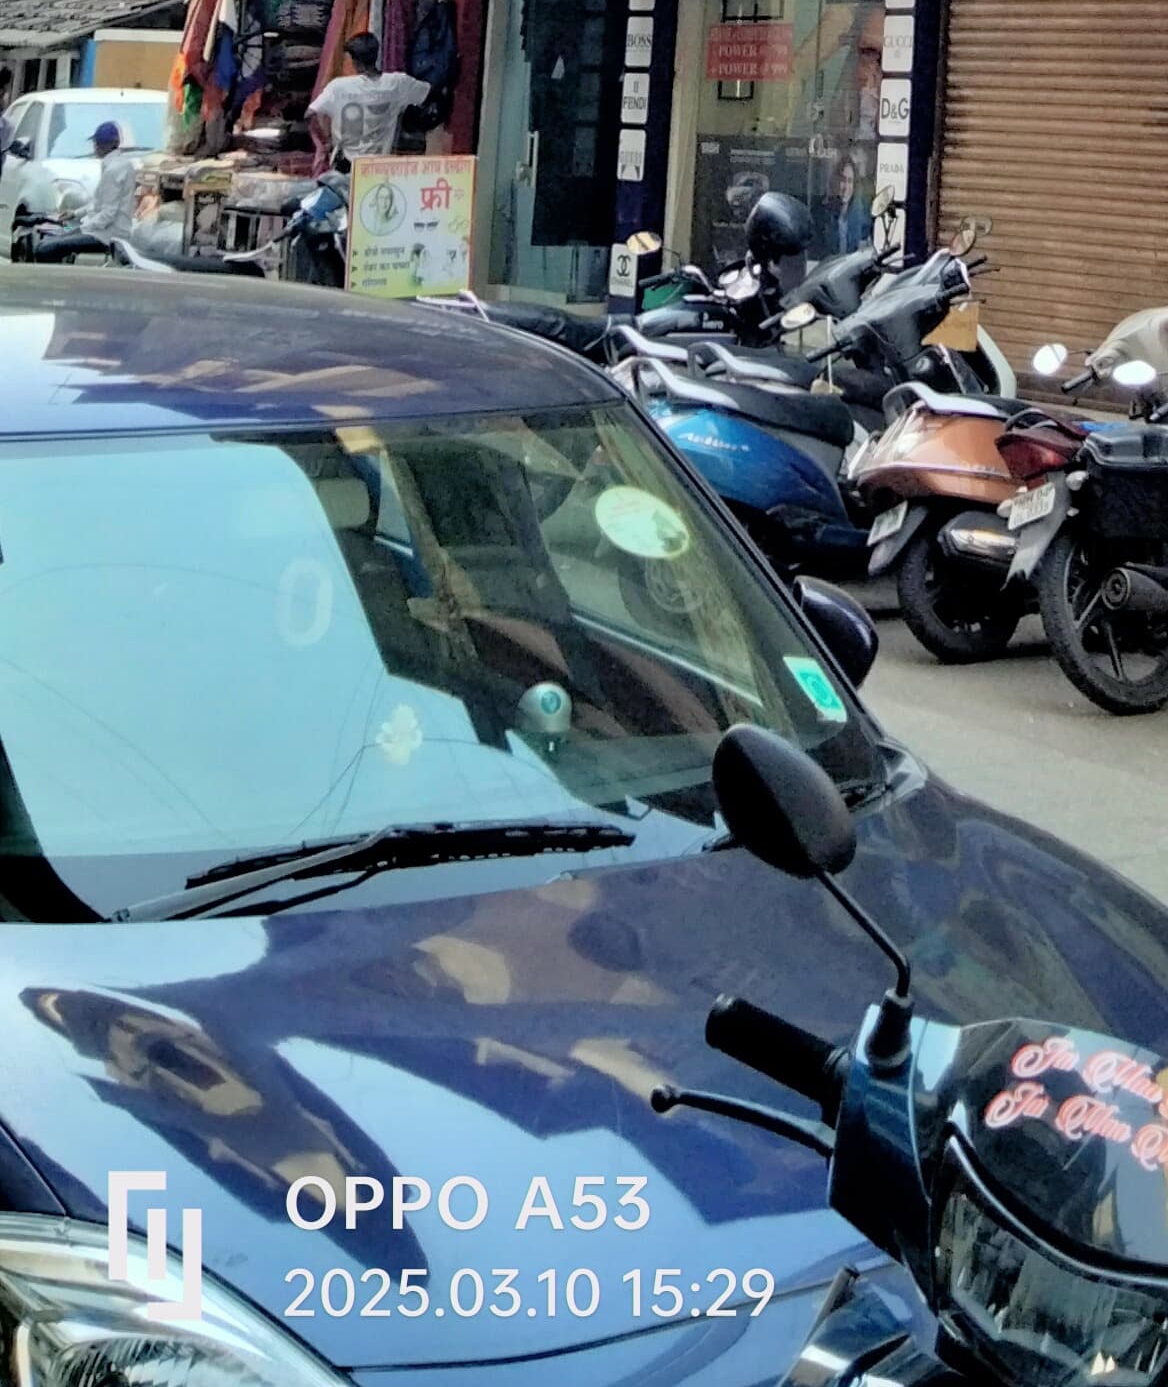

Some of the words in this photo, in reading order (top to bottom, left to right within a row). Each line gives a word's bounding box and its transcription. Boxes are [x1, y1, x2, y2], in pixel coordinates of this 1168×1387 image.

[627, 35, 652, 47] BOSS
[719, 44, 757, 58] POWER
[719, 63, 758, 75] POWER
[623, 96, 647, 110] FENDI
[881, 98, 910, 120] D&G
[880, 163, 905, 175] PRADA
[421, 177, 452, 211] फ्री
